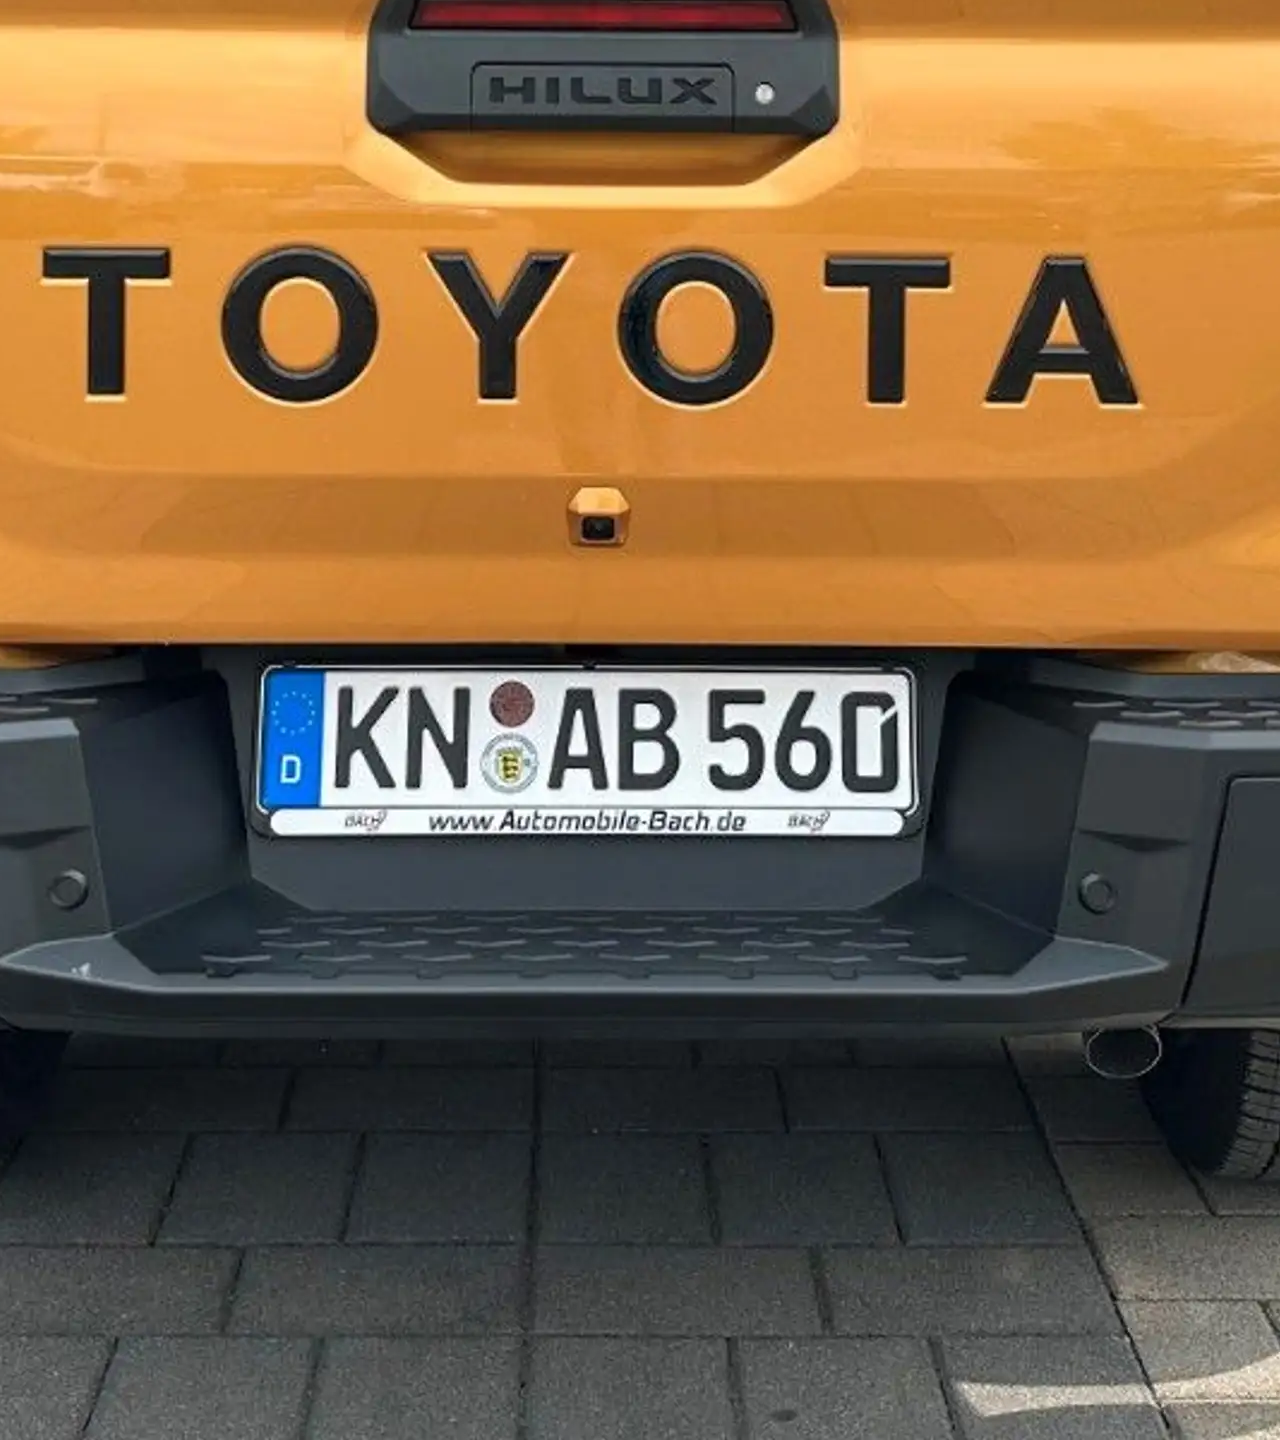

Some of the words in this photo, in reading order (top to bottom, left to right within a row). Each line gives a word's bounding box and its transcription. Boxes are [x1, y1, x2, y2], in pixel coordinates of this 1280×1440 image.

[488, 76, 717, 106] HILUX
[40, 244, 1142, 408] TOYOTA
[334, 686, 471, 789] KN
[546, 687, 681, 791] AB
[707, 688, 900, 794] 560
[280, 754, 302, 784] D
[428, 809, 747, 833] www.Automobile-Bach.de
